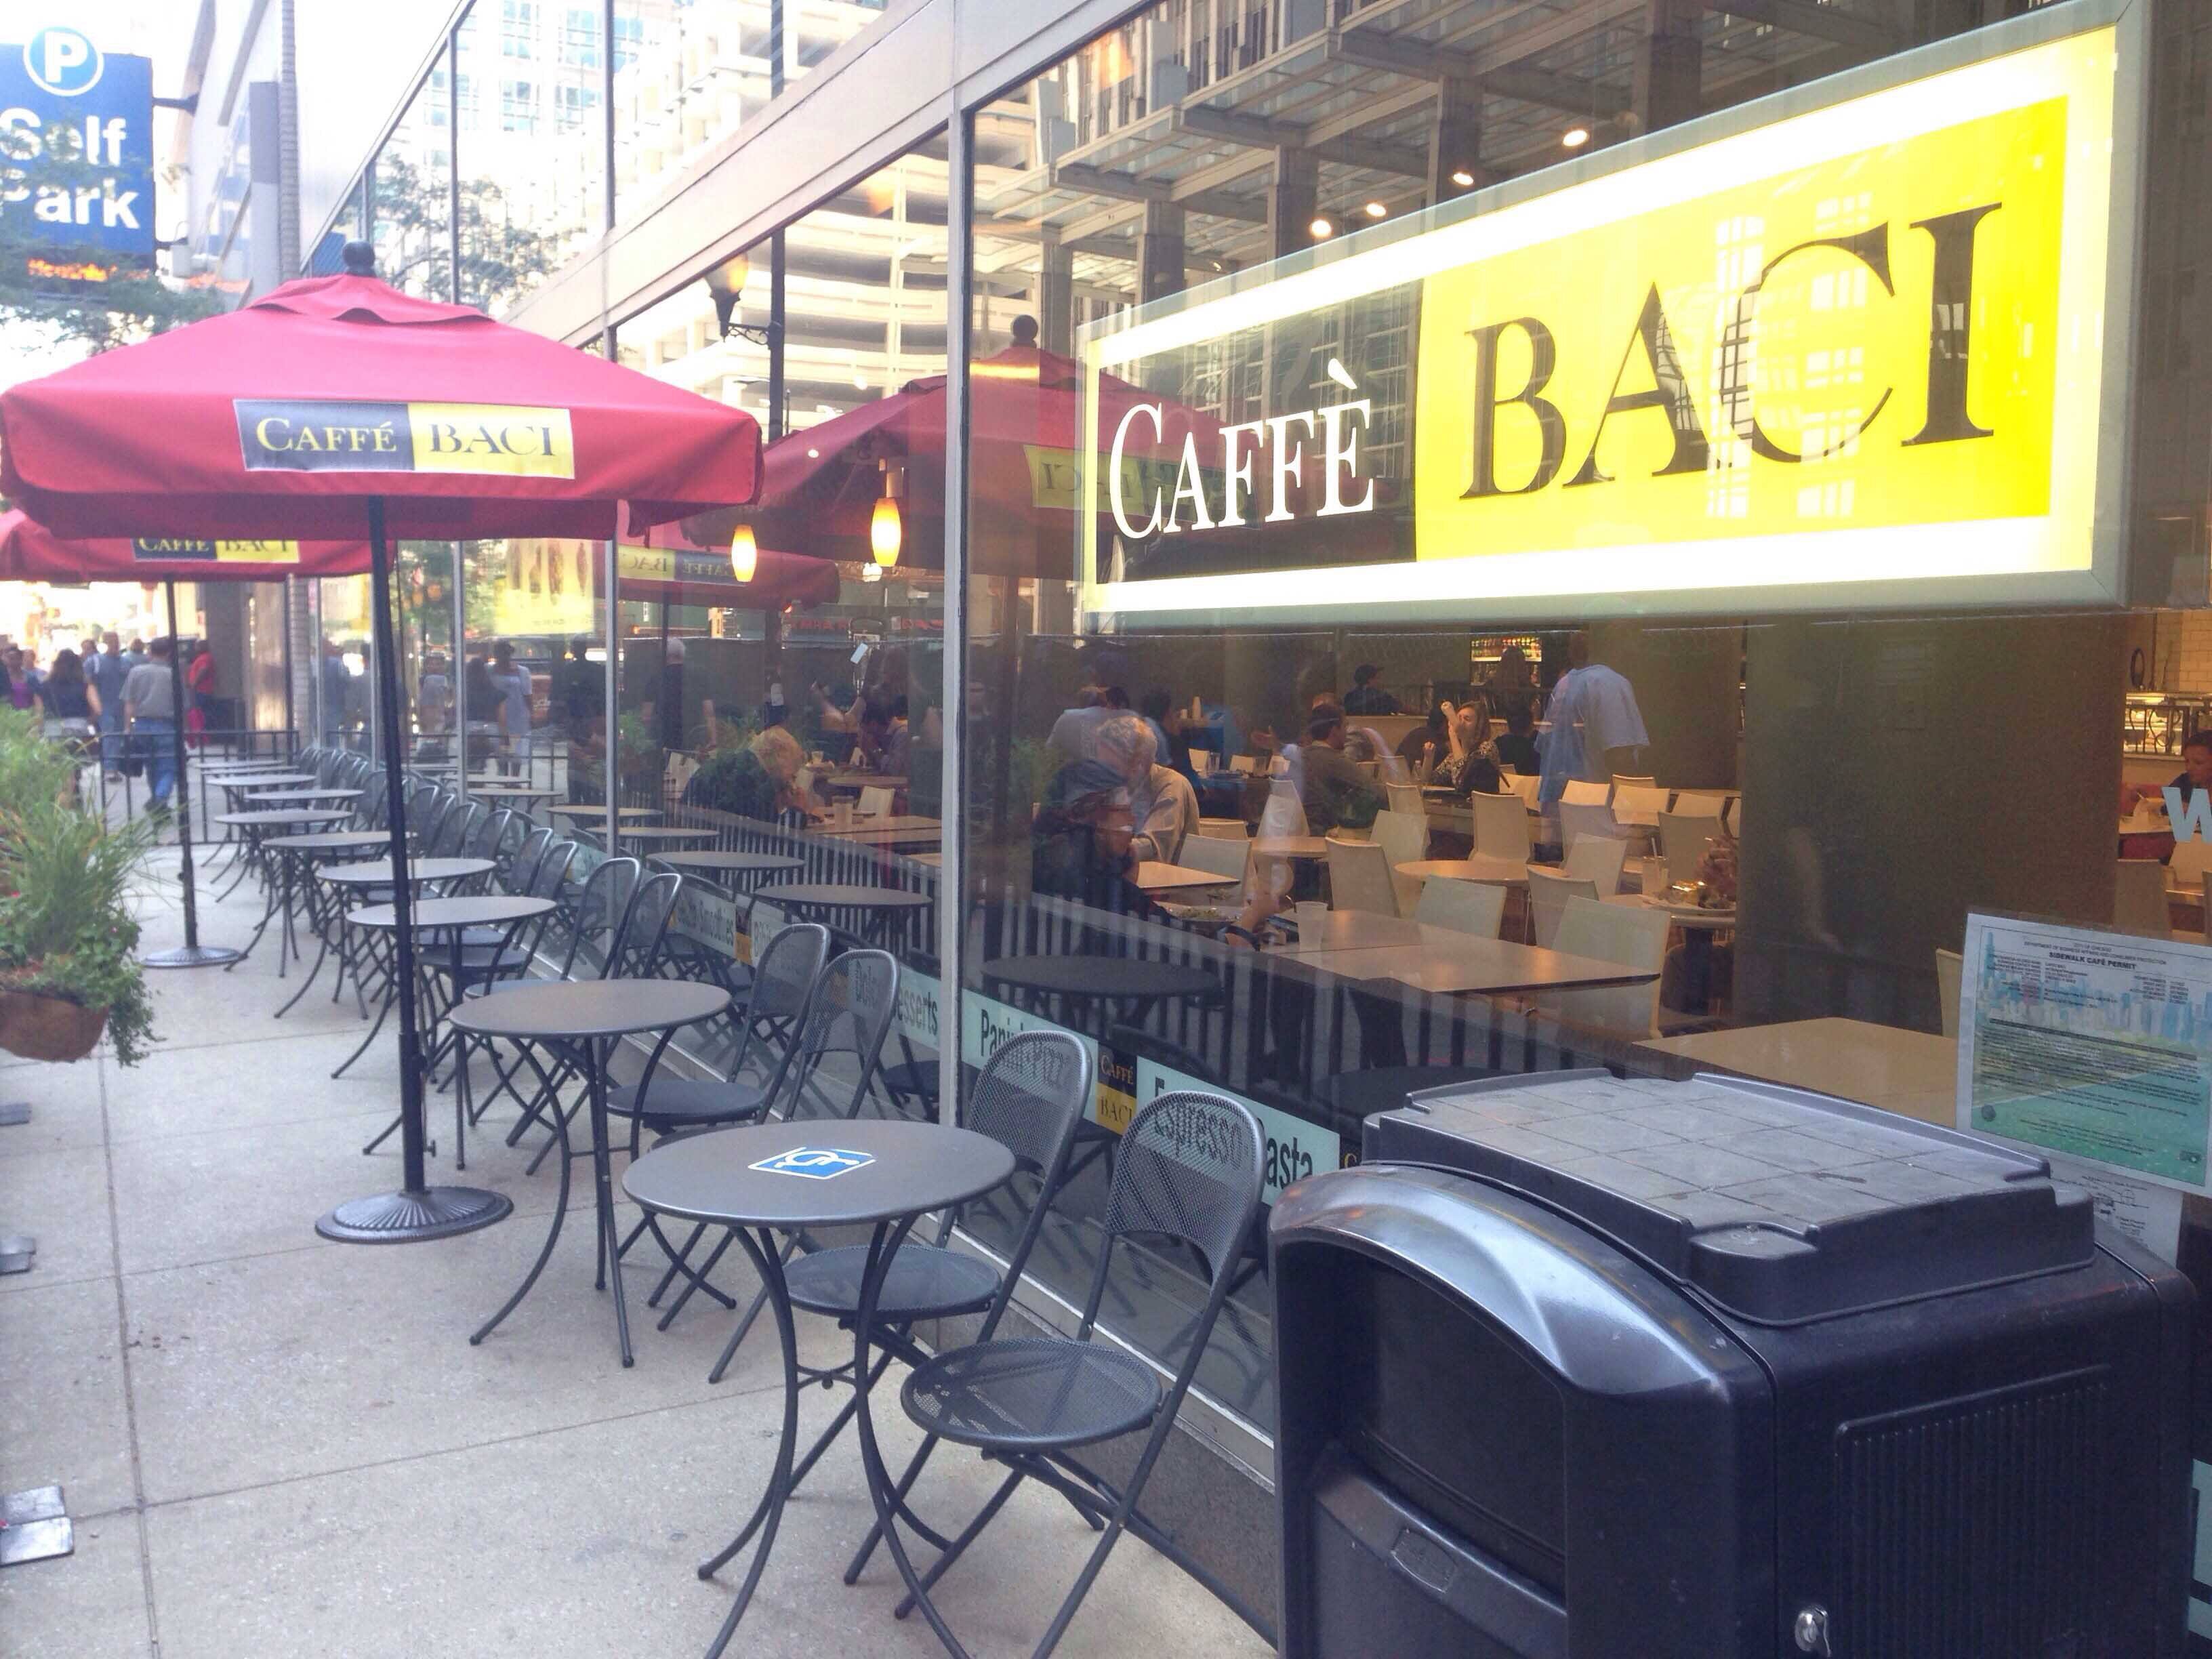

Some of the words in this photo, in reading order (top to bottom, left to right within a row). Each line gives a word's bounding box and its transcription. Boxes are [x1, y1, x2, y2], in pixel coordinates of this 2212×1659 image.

[44, 31, 88, 83] P
[0, 108, 126, 167] Self
[1109, 358, 1374, 539] CAFFÈ
[1459, 202, 2002, 499] BACI
[255, 417, 397, 453] CAFFÉ
[428, 424, 556, 457] BACI
[2049, 952, 2085, 962] SIDEWALK
[2108, 960, 2136, 970] PERMIT
[895, 985, 938, 1037] esserts
[1101, 1054, 1134, 1085] CAFFÉ
[1101, 1096, 1132, 1124] BACI
[1153, 1076, 1242, 1170] Espresso
[1256, 1117, 1313, 1189] asta
